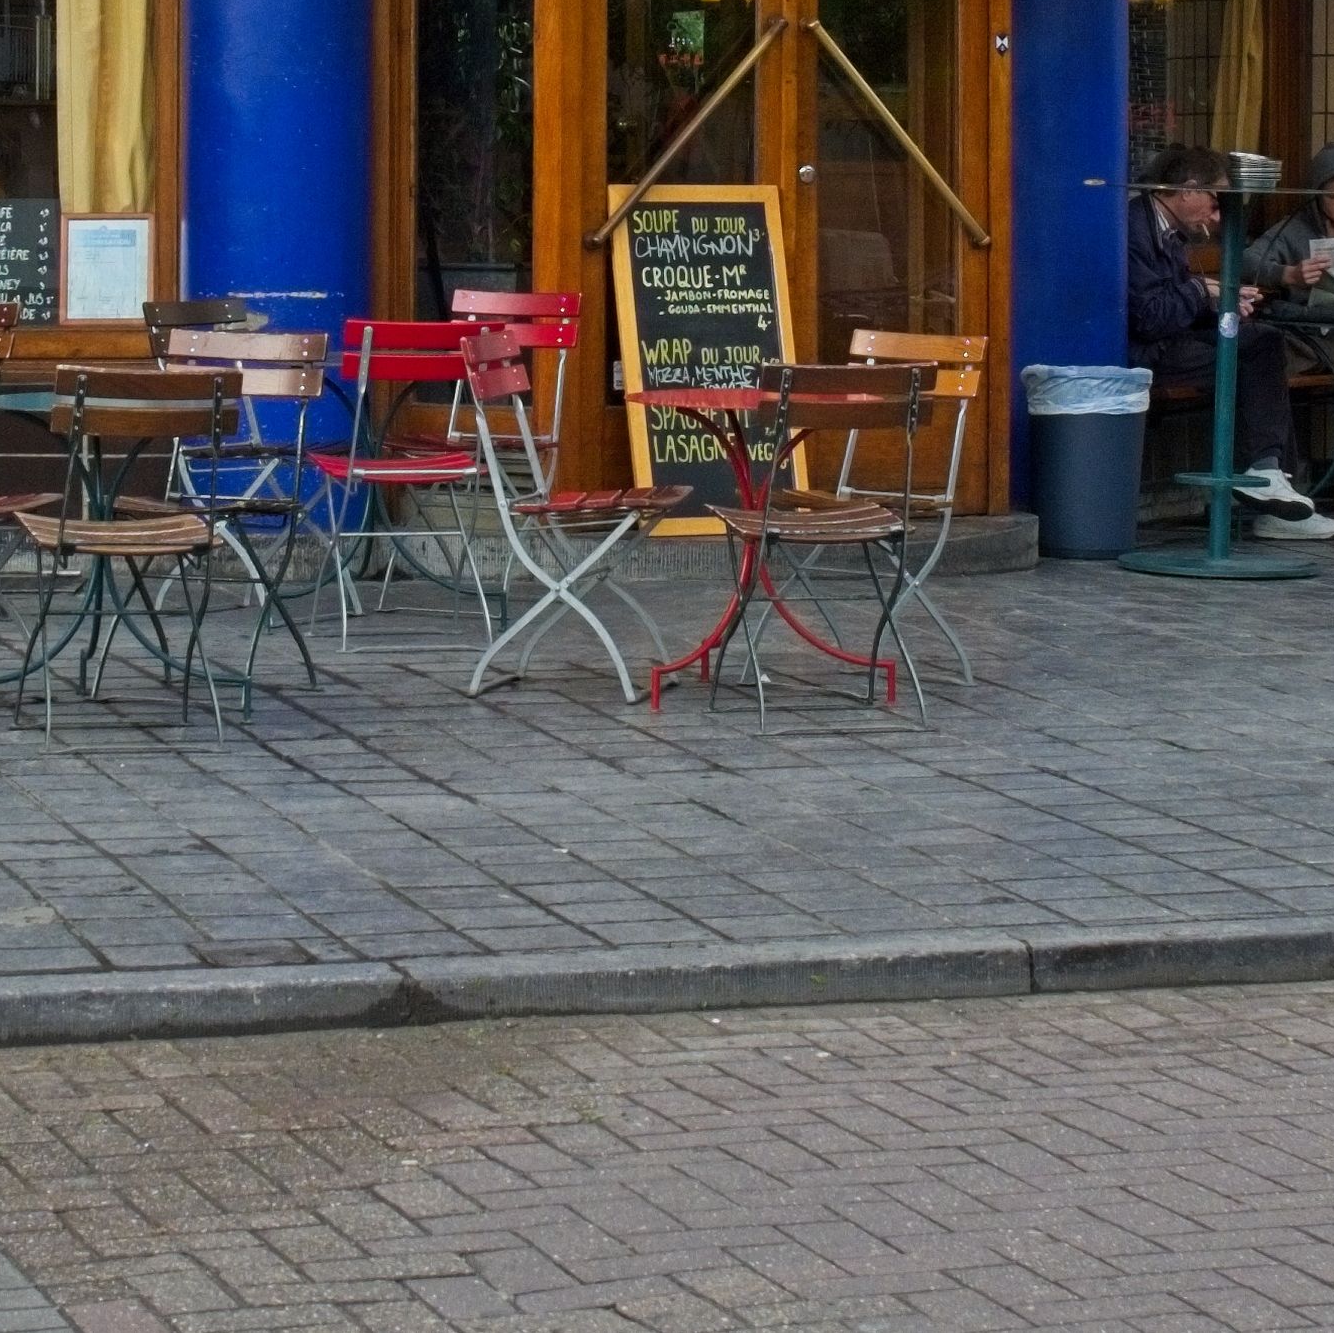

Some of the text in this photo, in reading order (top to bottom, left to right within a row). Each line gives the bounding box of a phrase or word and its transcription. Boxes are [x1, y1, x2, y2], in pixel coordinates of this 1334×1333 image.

[632, 209, 746, 235] SOUPE DU JOUR
[635, 230, 753, 263] CHAMPIGNON
[641, 338, 761, 365] WRAP DU JOUR
